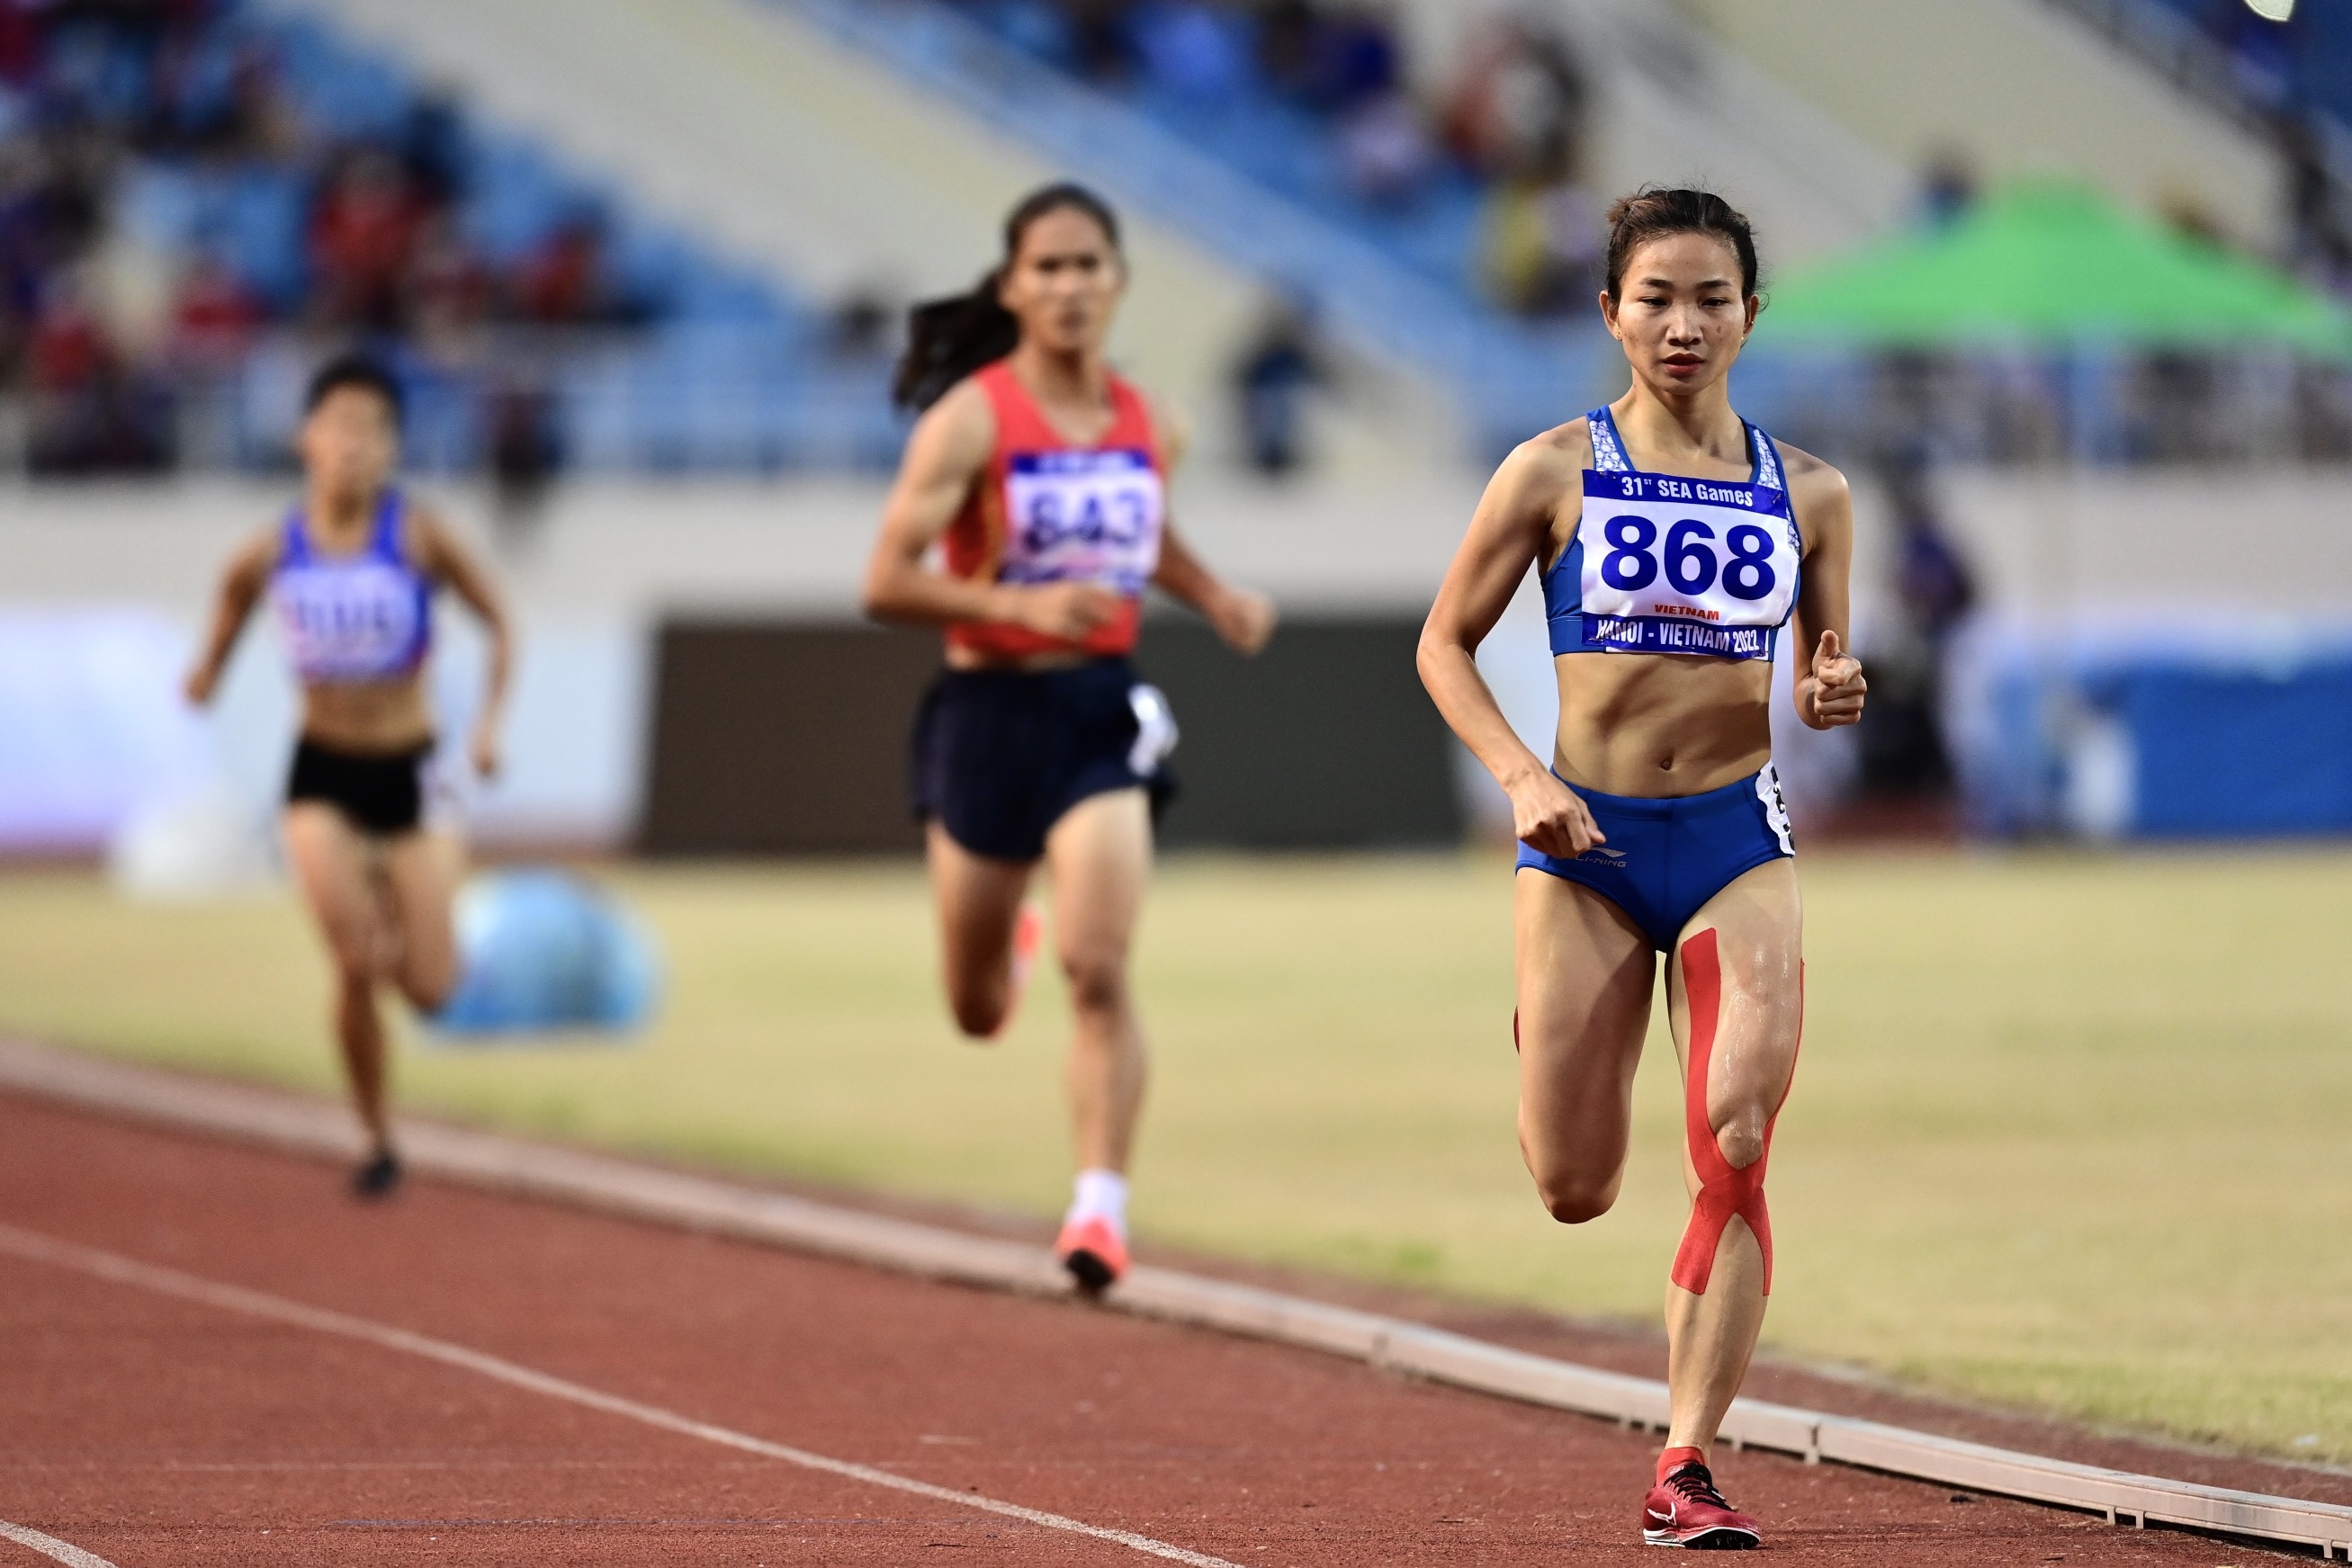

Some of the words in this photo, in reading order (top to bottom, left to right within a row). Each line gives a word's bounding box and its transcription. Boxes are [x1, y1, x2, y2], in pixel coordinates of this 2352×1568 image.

[1657, 479, 1692, 499] SEA
[1696, 483, 1754, 507] Games
[1601, 515, 1776, 601] 868
[1654, 604, 1719, 621] VIETNAM
[1596, 619, 1644, 644] HANOI
[1659, 623, 1729, 651] VIETNAM
[1733, 630, 1760, 653] 2022
